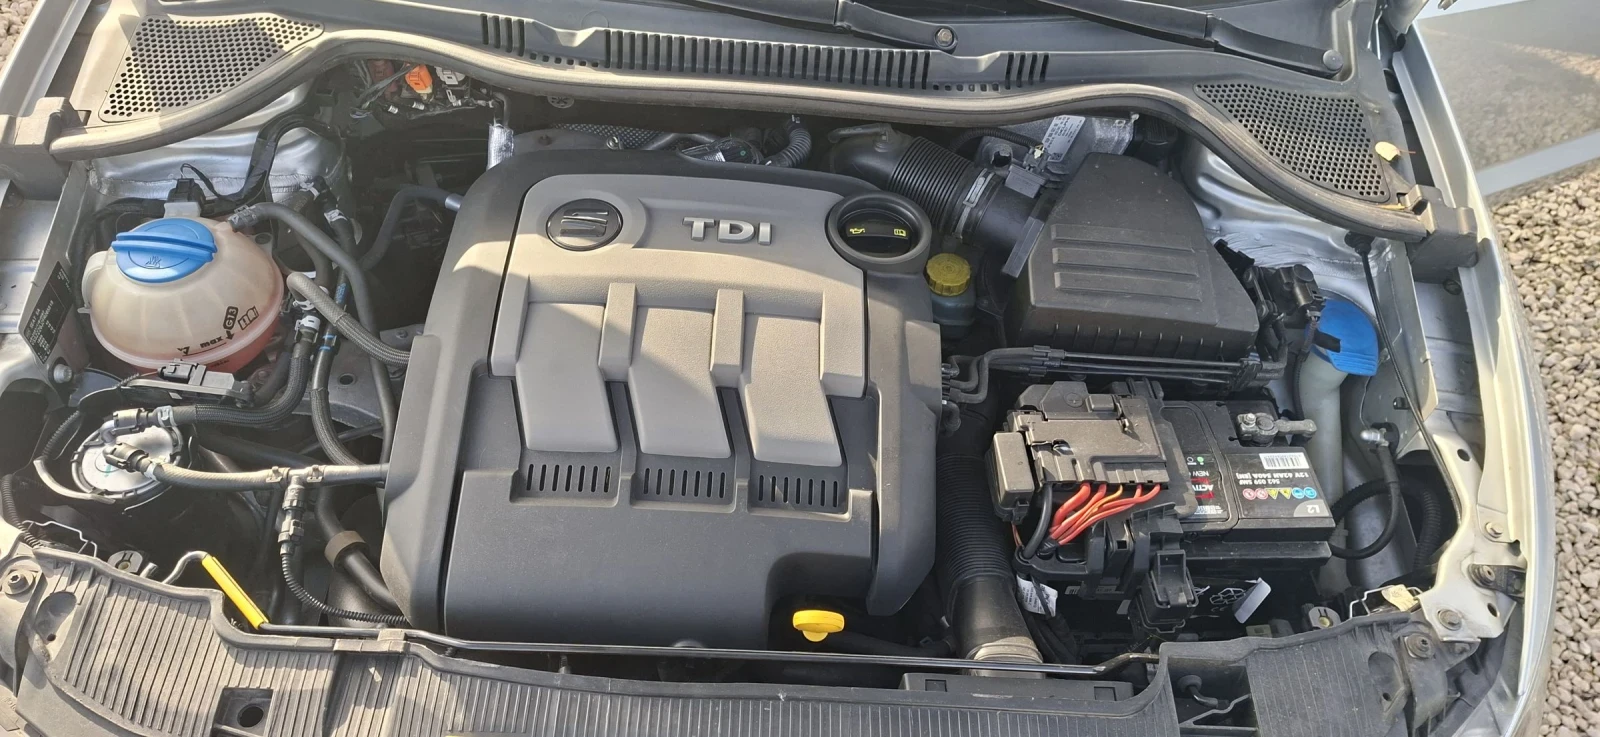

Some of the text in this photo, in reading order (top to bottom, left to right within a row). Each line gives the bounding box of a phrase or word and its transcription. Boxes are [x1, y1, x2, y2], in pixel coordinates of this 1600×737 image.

[682, 217, 772, 245] TDI
[226, 308, 236, 326] G13
[200, 336, 223, 348] max
[1306, 504, 1320, 513] L2
